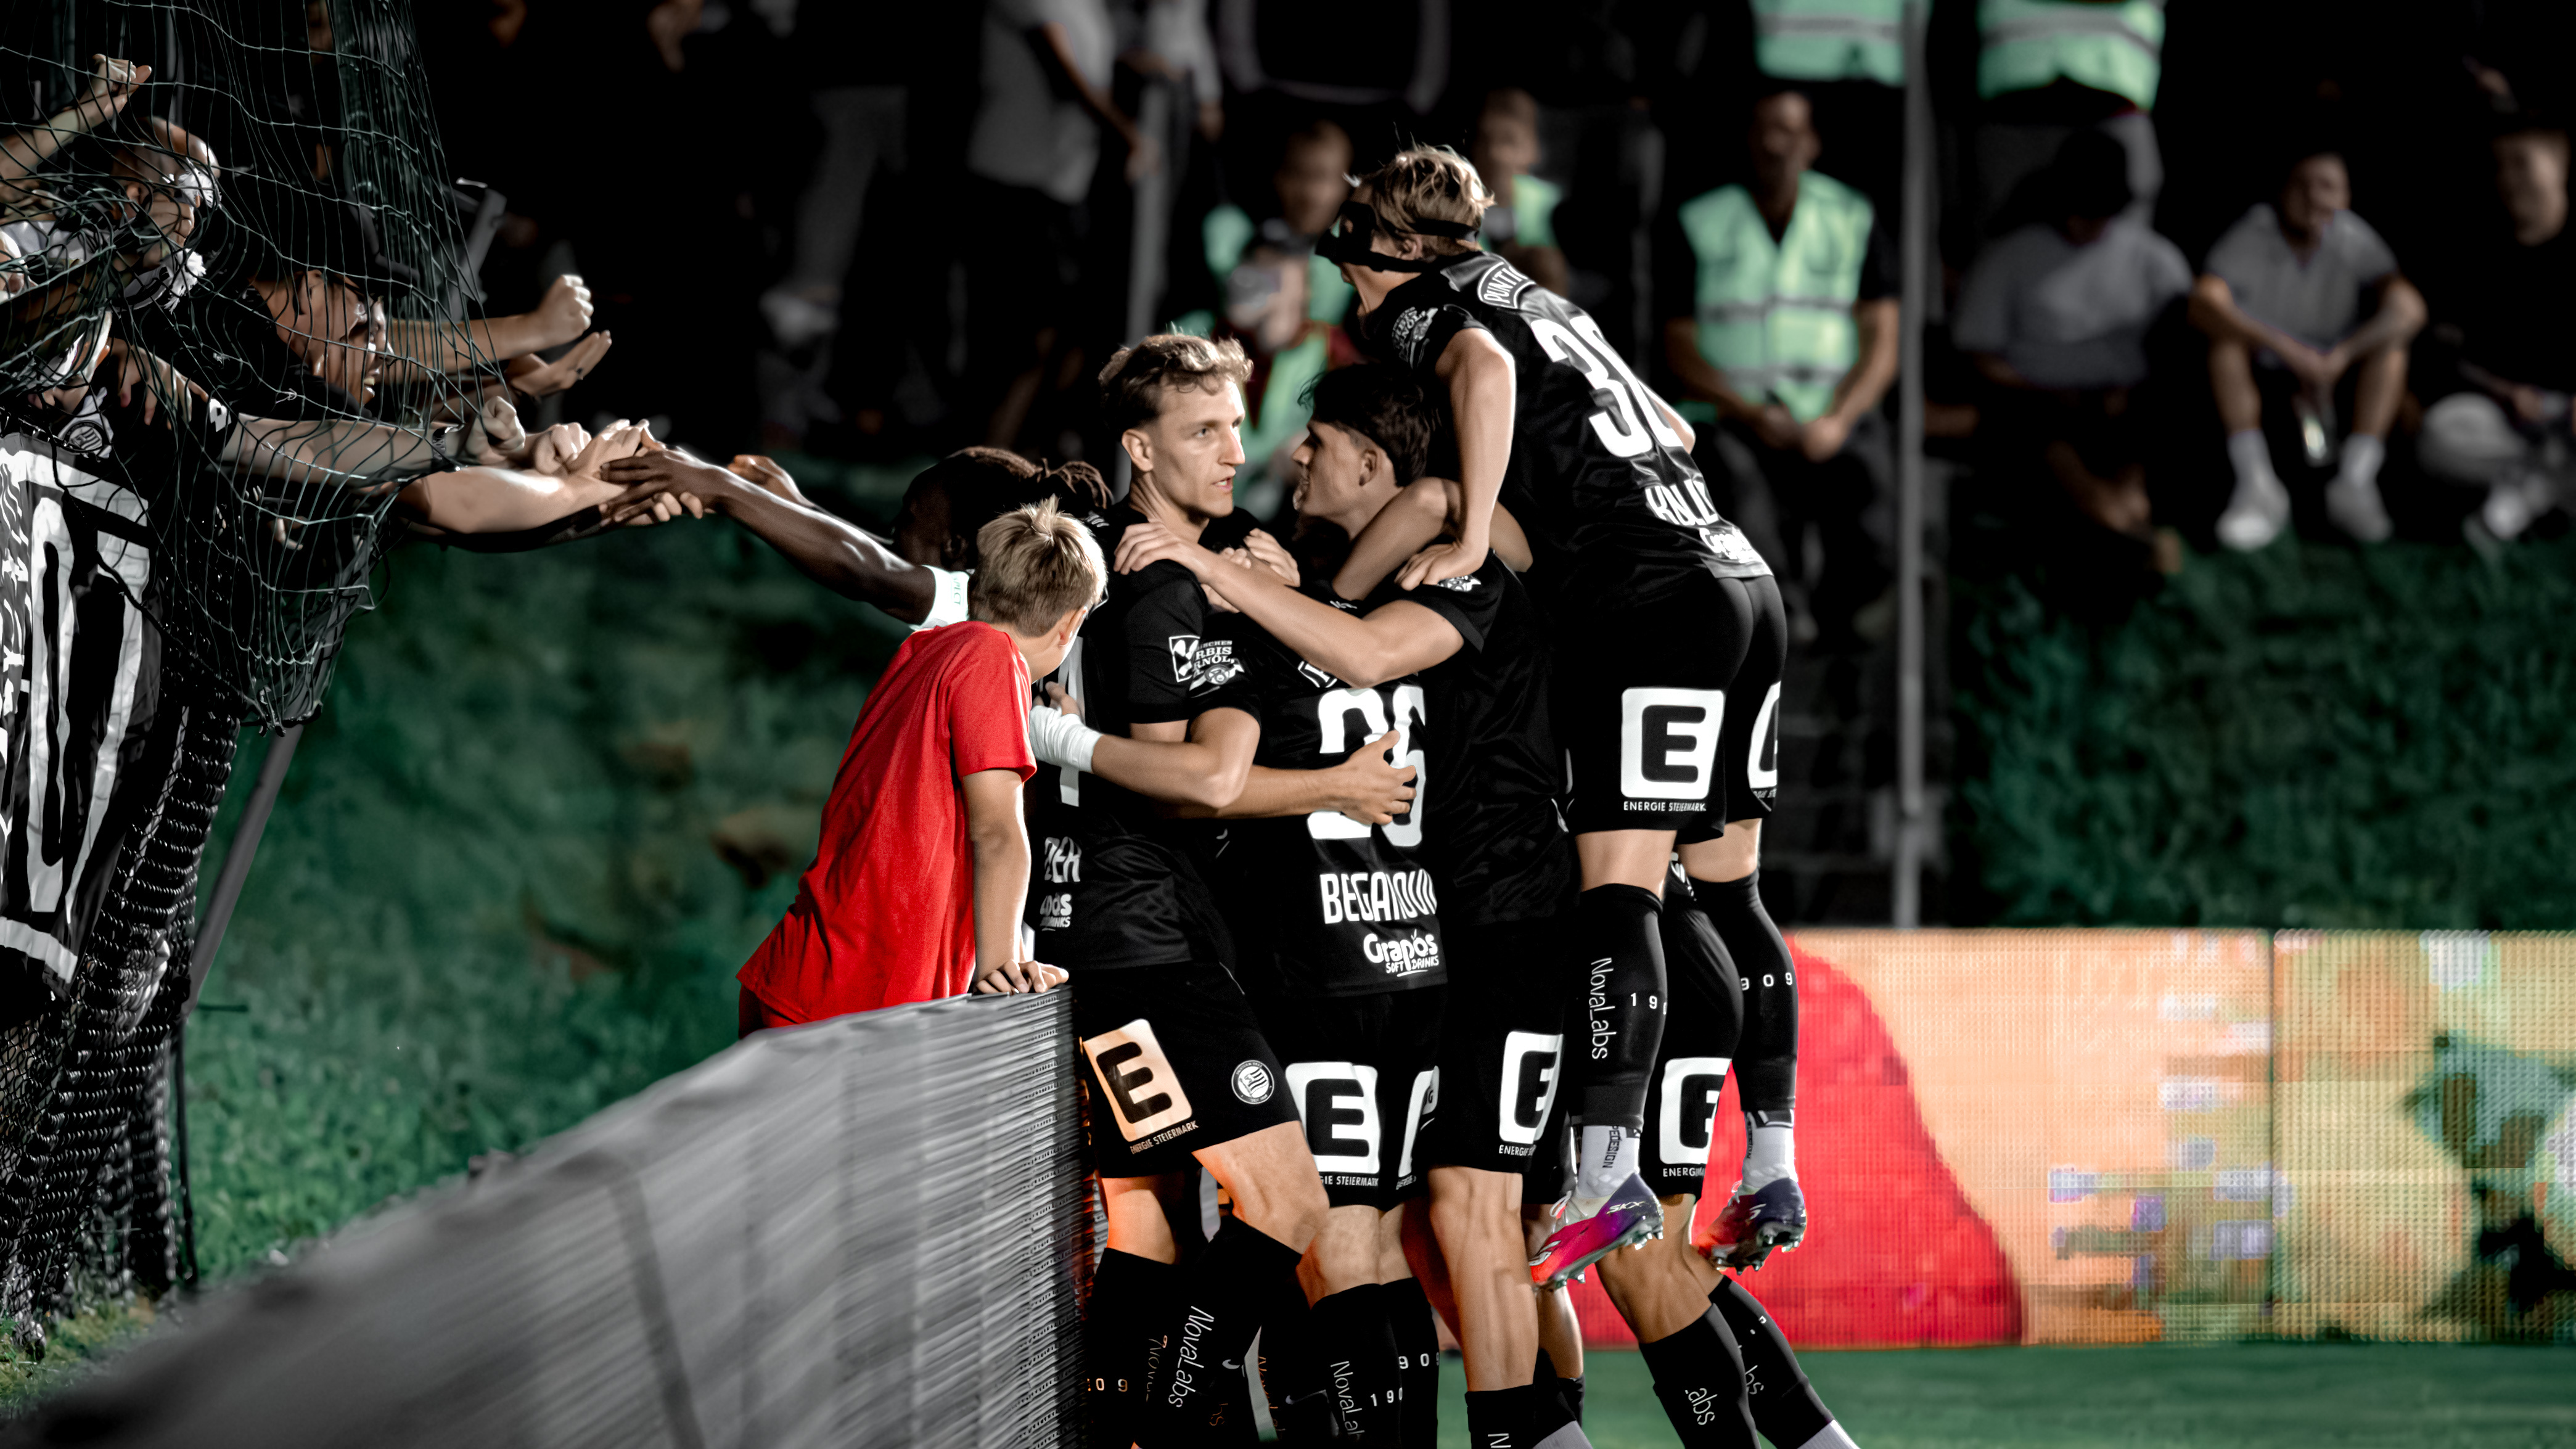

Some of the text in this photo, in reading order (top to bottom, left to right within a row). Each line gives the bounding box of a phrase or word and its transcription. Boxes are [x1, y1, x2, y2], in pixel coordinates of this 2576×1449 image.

[1531, 315, 1684, 458] 30
[1641, 705, 1706, 783] E
[1623, 801, 1707, 812] ENERGIE STEIERMARK
[1385, 955, 1439, 974] SOFT DRINKS
[1589, 958, 1617, 1059] NovaLabs
[1096, 1041, 1173, 1124] E
[1305, 1078, 1369, 1157] E
[1152, 1120, 1199, 1145] STEIERMARK
[1336, 1176, 1379, 1186] STEIERMARK
[1168, 1305, 1215, 1408] NovaLabs
